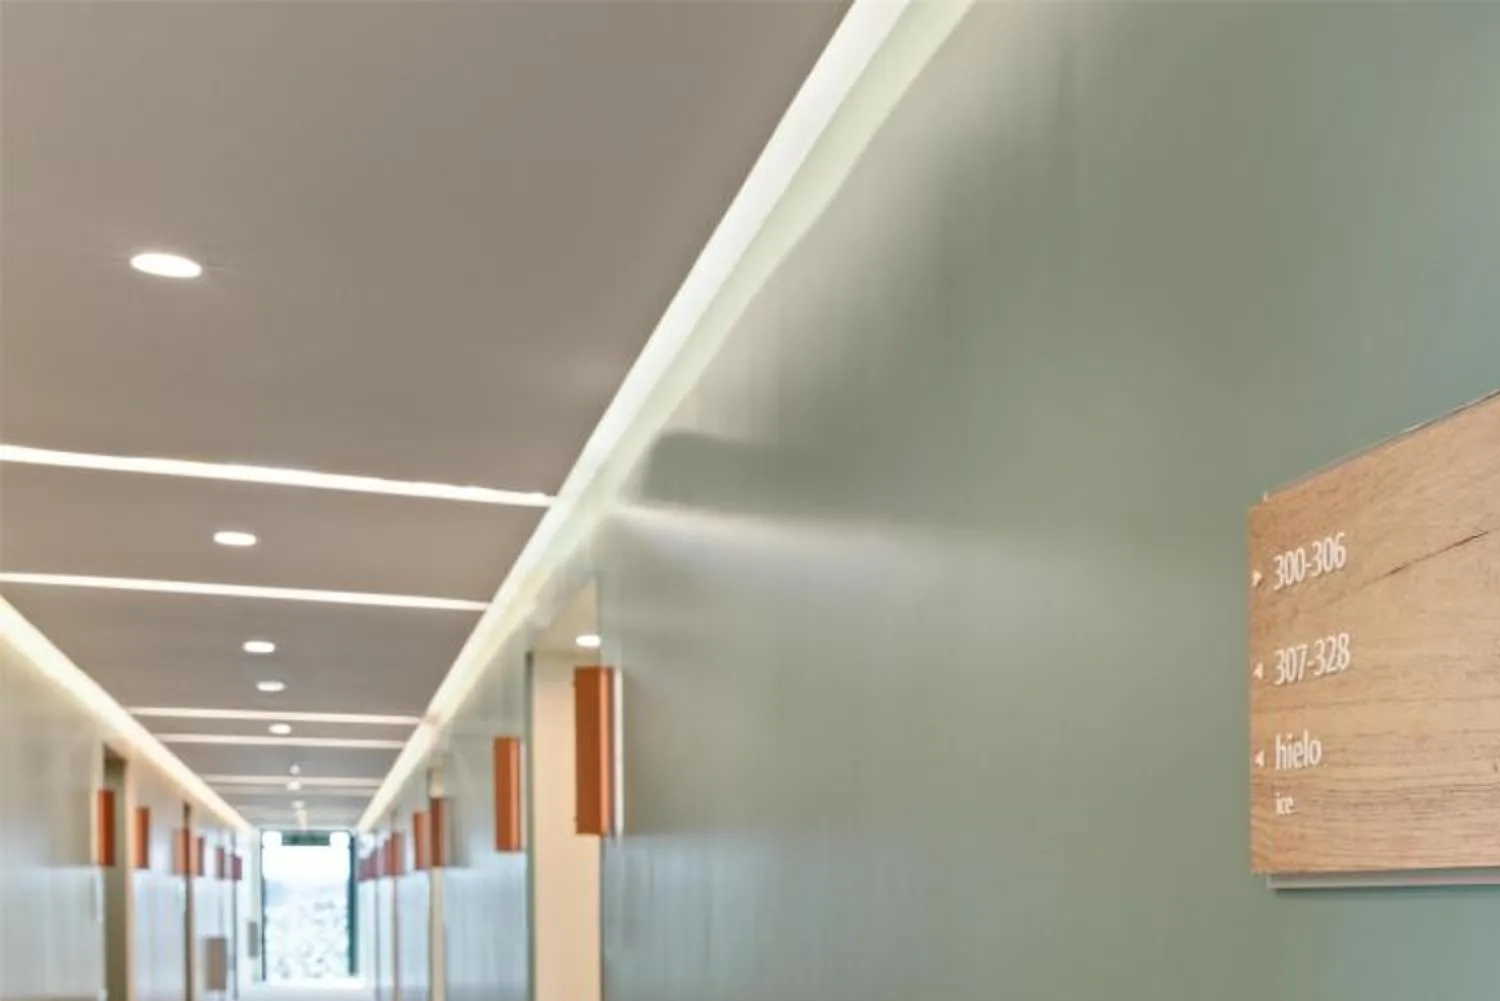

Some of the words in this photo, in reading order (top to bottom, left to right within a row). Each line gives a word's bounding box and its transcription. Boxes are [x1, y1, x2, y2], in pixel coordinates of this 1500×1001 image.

[1273, 532, 1346, 591] 300-306
[1273, 633, 1350, 685] 307-328
[1275, 729, 1322, 770] hielo
[1275, 792, 1294, 815] ice
